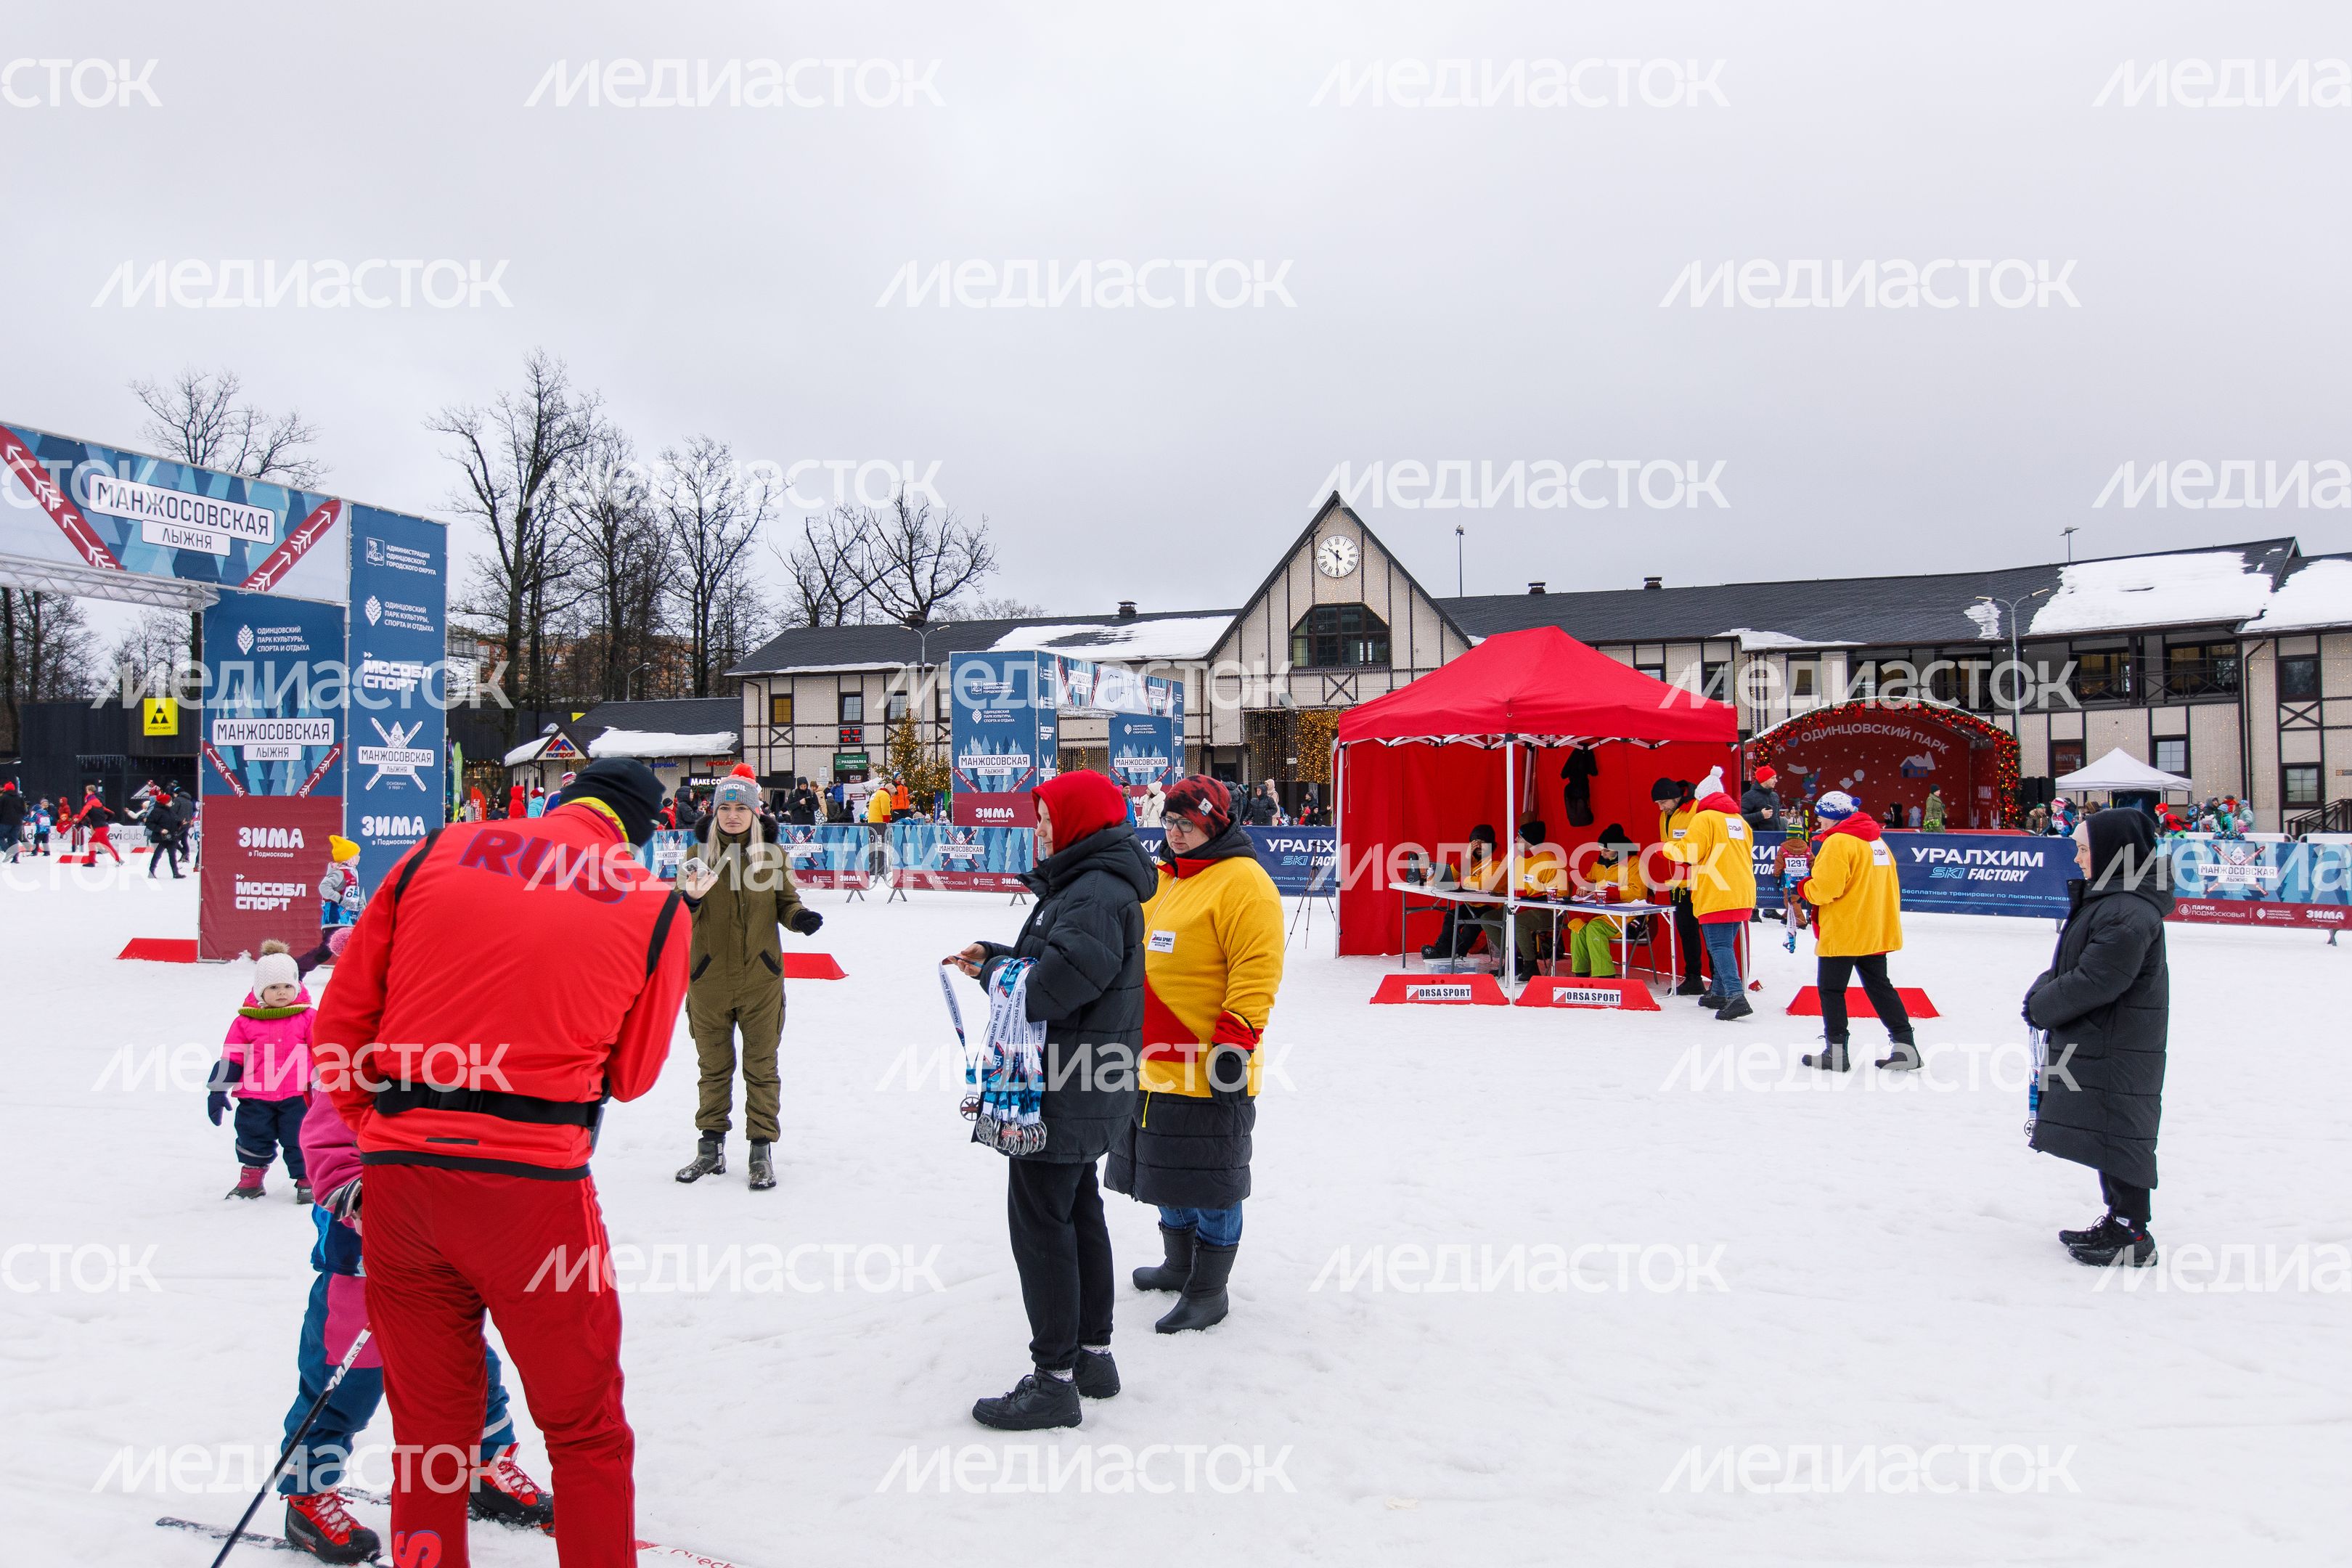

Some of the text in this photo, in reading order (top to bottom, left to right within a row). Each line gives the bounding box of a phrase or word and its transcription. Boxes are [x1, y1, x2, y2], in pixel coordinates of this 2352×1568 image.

[98, 482, 269, 536] МАНЖОСОВСКАЯ
[162, 528, 213, 550] ЛЫЖНЯ
[386, 544, 430, 559] АДМИНИСТРАЦИЯ
[386, 552, 427, 565] ОДИНЦОВСКОГО
[386, 560, 436, 576] ГОРОДСКОГО ОКРУГА
[385, 601, 427, 614] ОДИНЦОВСКИЙ
[385, 610, 429, 624] ПАРК КУЛЬТУРЫ,
[257, 626, 301, 634] ОДИНЦОВСКИЙ
[384, 620, 406, 629] СПОРТА
[412, 623, 434, 632] ОТДЫХА
[273, 635, 304, 644] КУЛЬТУРЫ,
[364, 660, 432, 679] МОСОБЛ
[364, 674, 417, 692] СПОРТ
[217, 723, 330, 740] МАНЖОСОВСКАЯ
[1775, 723, 1950, 754] Я ОДИНЦОВСКИЙ ПАРК
[256, 747, 290, 758] ЛЫЖНЯ
[362, 749, 432, 763] МАНЖОСОВСКАЯ
[960, 756, 1028, 767] МАНЖОСОВСКАЯ
[711, 777, 724, 785] CO
[719, 783, 746, 792] LUKOIL
[975, 807, 1015, 818] ЗИМА
[362, 815, 426, 836] ЗИМА
[238, 827, 304, 849] ЗИМА
[1266, 838, 1336, 853] УРАЛХ
[1281, 855, 1336, 866] SKI FACT
[1911, 847, 2044, 867] УРАЛХИМ
[458, 828, 632, 904] RUS
[2200, 866, 2275, 876] МАНЖОСОВСКАЯ
[1929, 867, 2030, 882] SKI FACTORY
[236, 882, 306, 897] МОСОБЛ
[236, 897, 291, 911] СПОРТ
[2306, 910, 2345, 920] ЗИМА
[1443, 988, 1471, 997] SPORT
[1567, 992, 1620, 1002] ORSA SPORT
[993, 1055, 1003, 1066] 54
